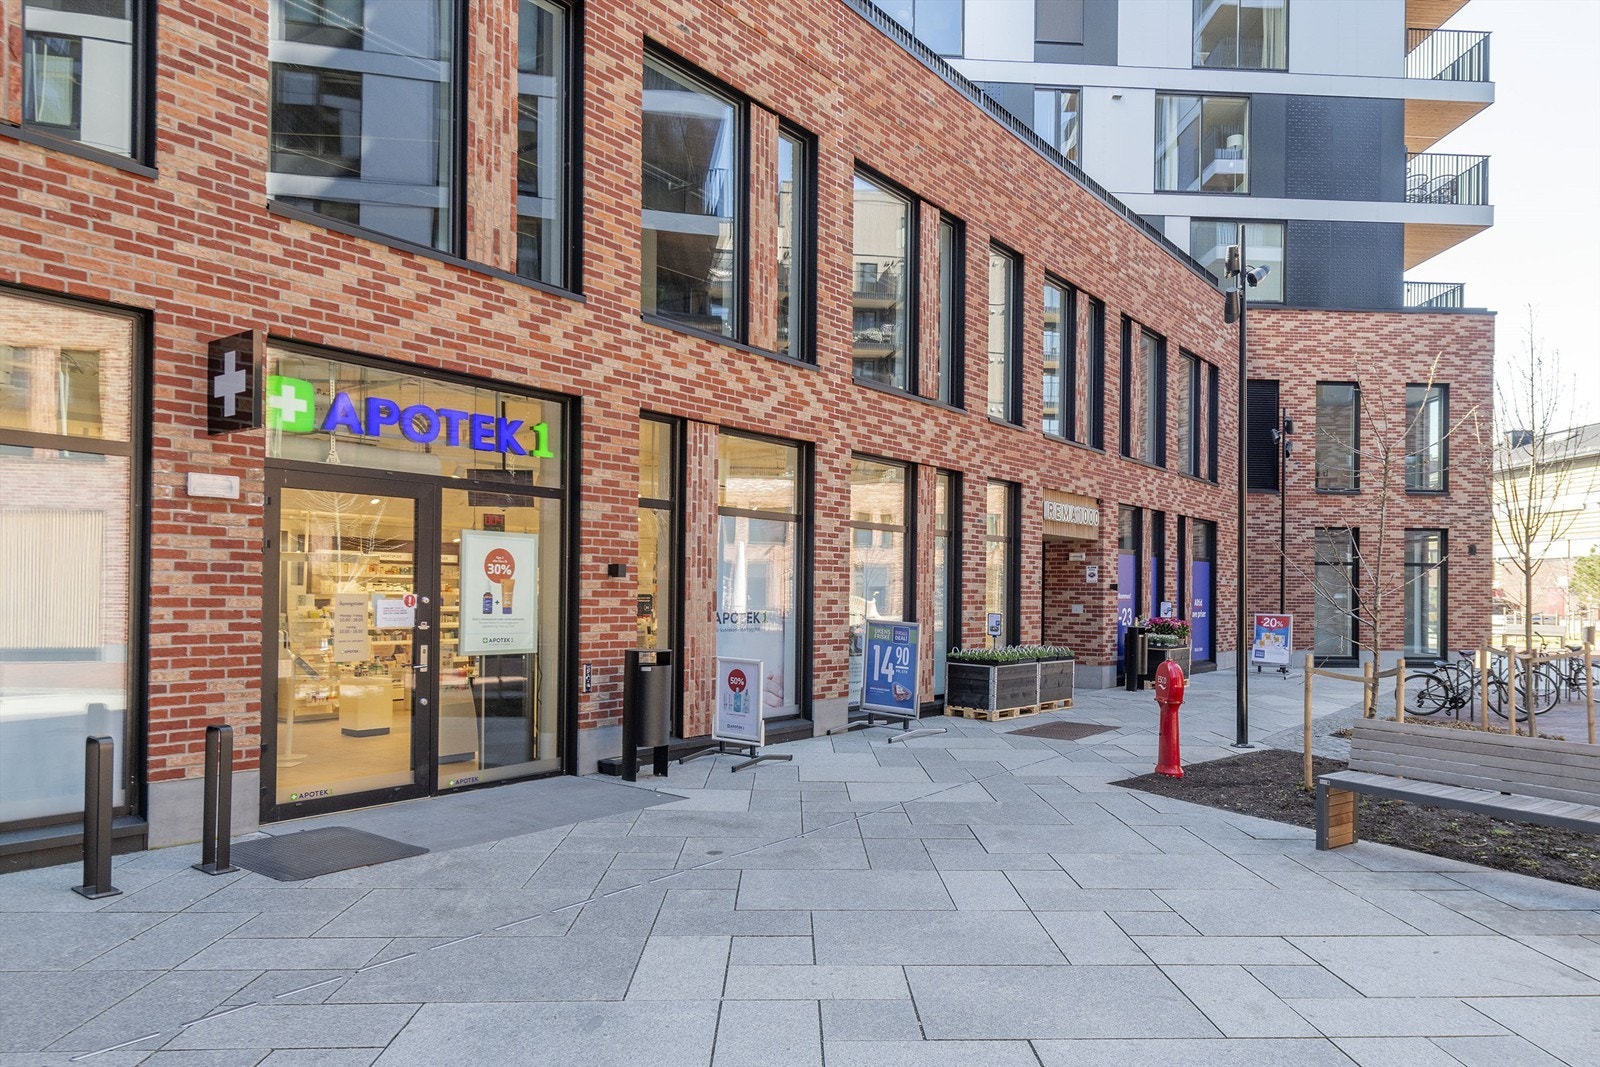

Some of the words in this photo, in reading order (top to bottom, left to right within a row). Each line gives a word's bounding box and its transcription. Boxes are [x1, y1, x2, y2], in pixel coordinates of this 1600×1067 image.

[321, 391, 528, 456] APOTEK
[531, 422, 554, 458] 1
[1047, 502, 1077, 524] REMA
[1077, 506, 1099, 526] 1000
[487, 563, 512, 575] 30%
[1117, 608, 1132, 626] -23
[1260, 617, 1284, 628] -20%
[896, 646, 910, 666] 90
[873, 645, 895, 683] 14
[730, 677, 745, 685] 50%
[455, 776, 479, 785] APOTEK
[299, 789, 329, 799] APOTEK
